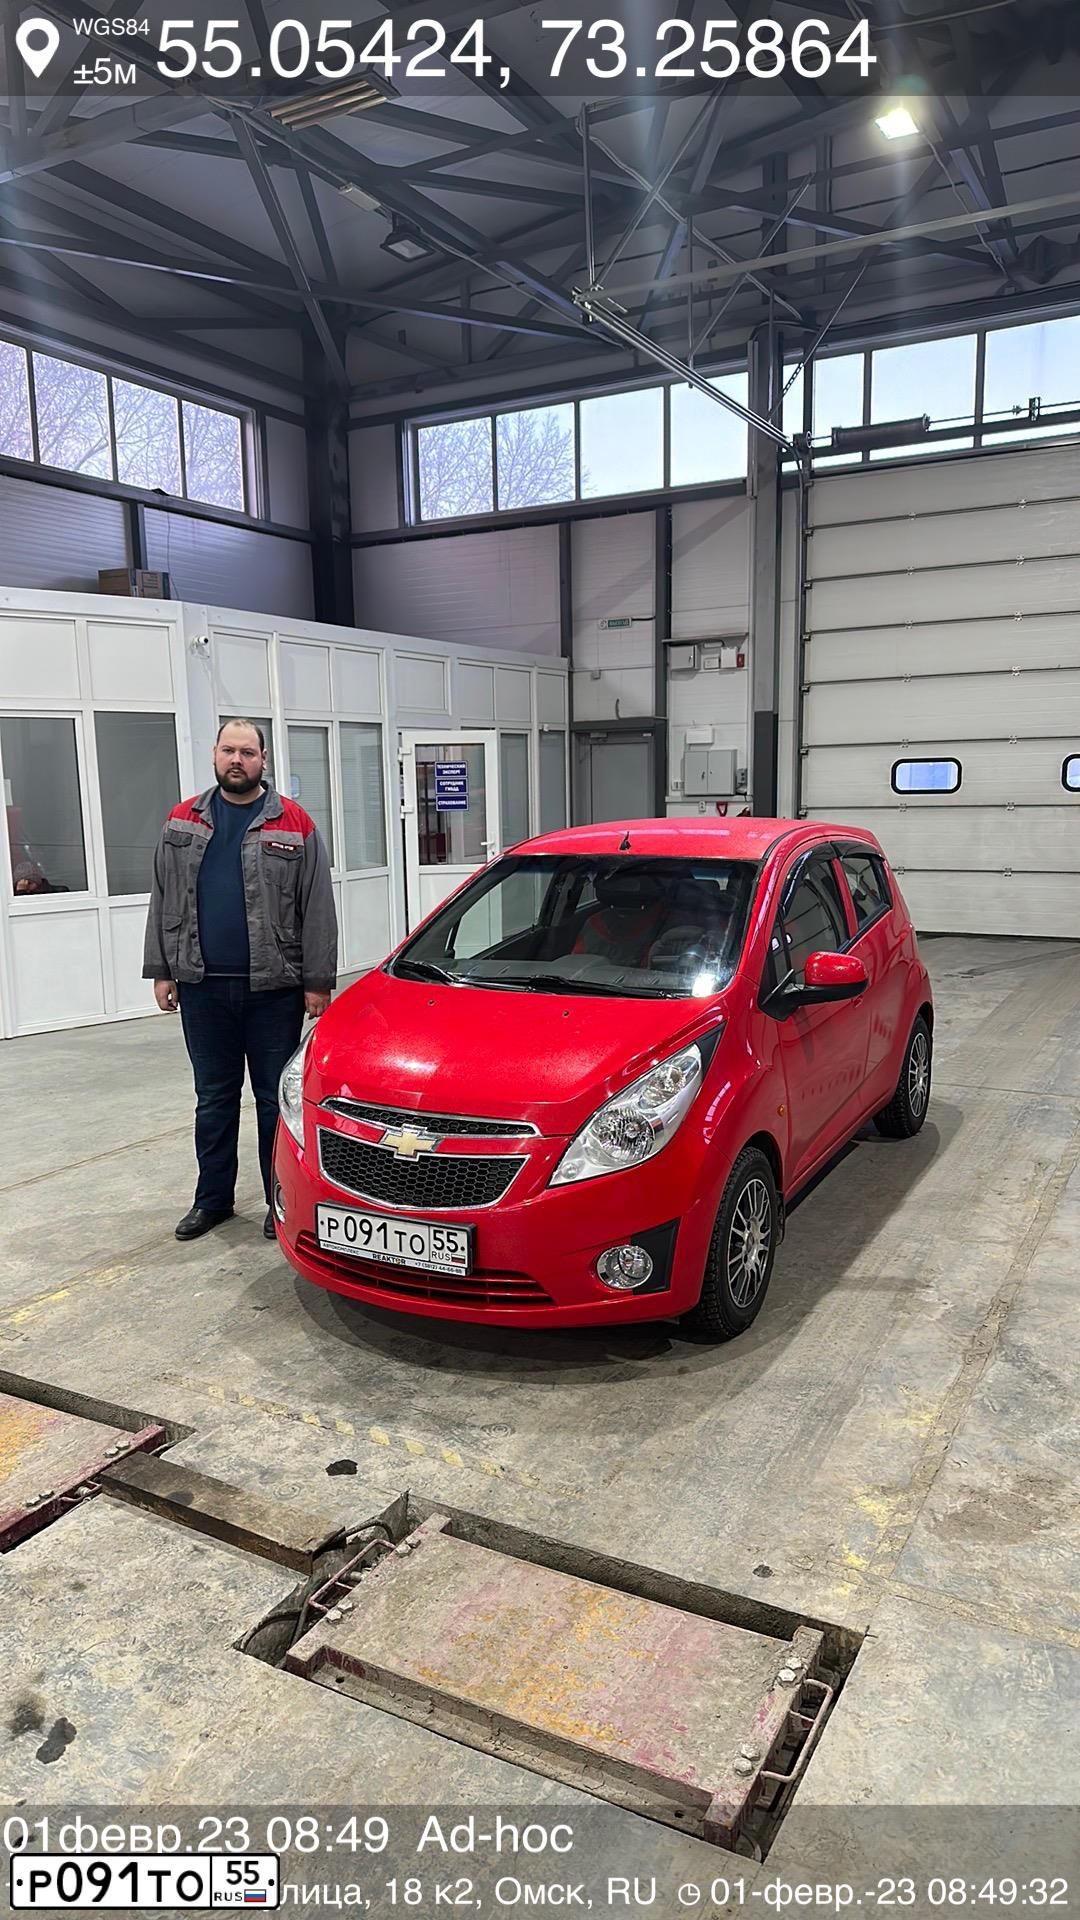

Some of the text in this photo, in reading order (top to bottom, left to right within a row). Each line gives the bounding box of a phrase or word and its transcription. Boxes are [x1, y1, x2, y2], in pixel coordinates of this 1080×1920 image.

[432, 1229, 459, 1254] 55
[372, 1253, 407, 1265] REAKTOR
[431, 1250, 451, 1261] RUS
